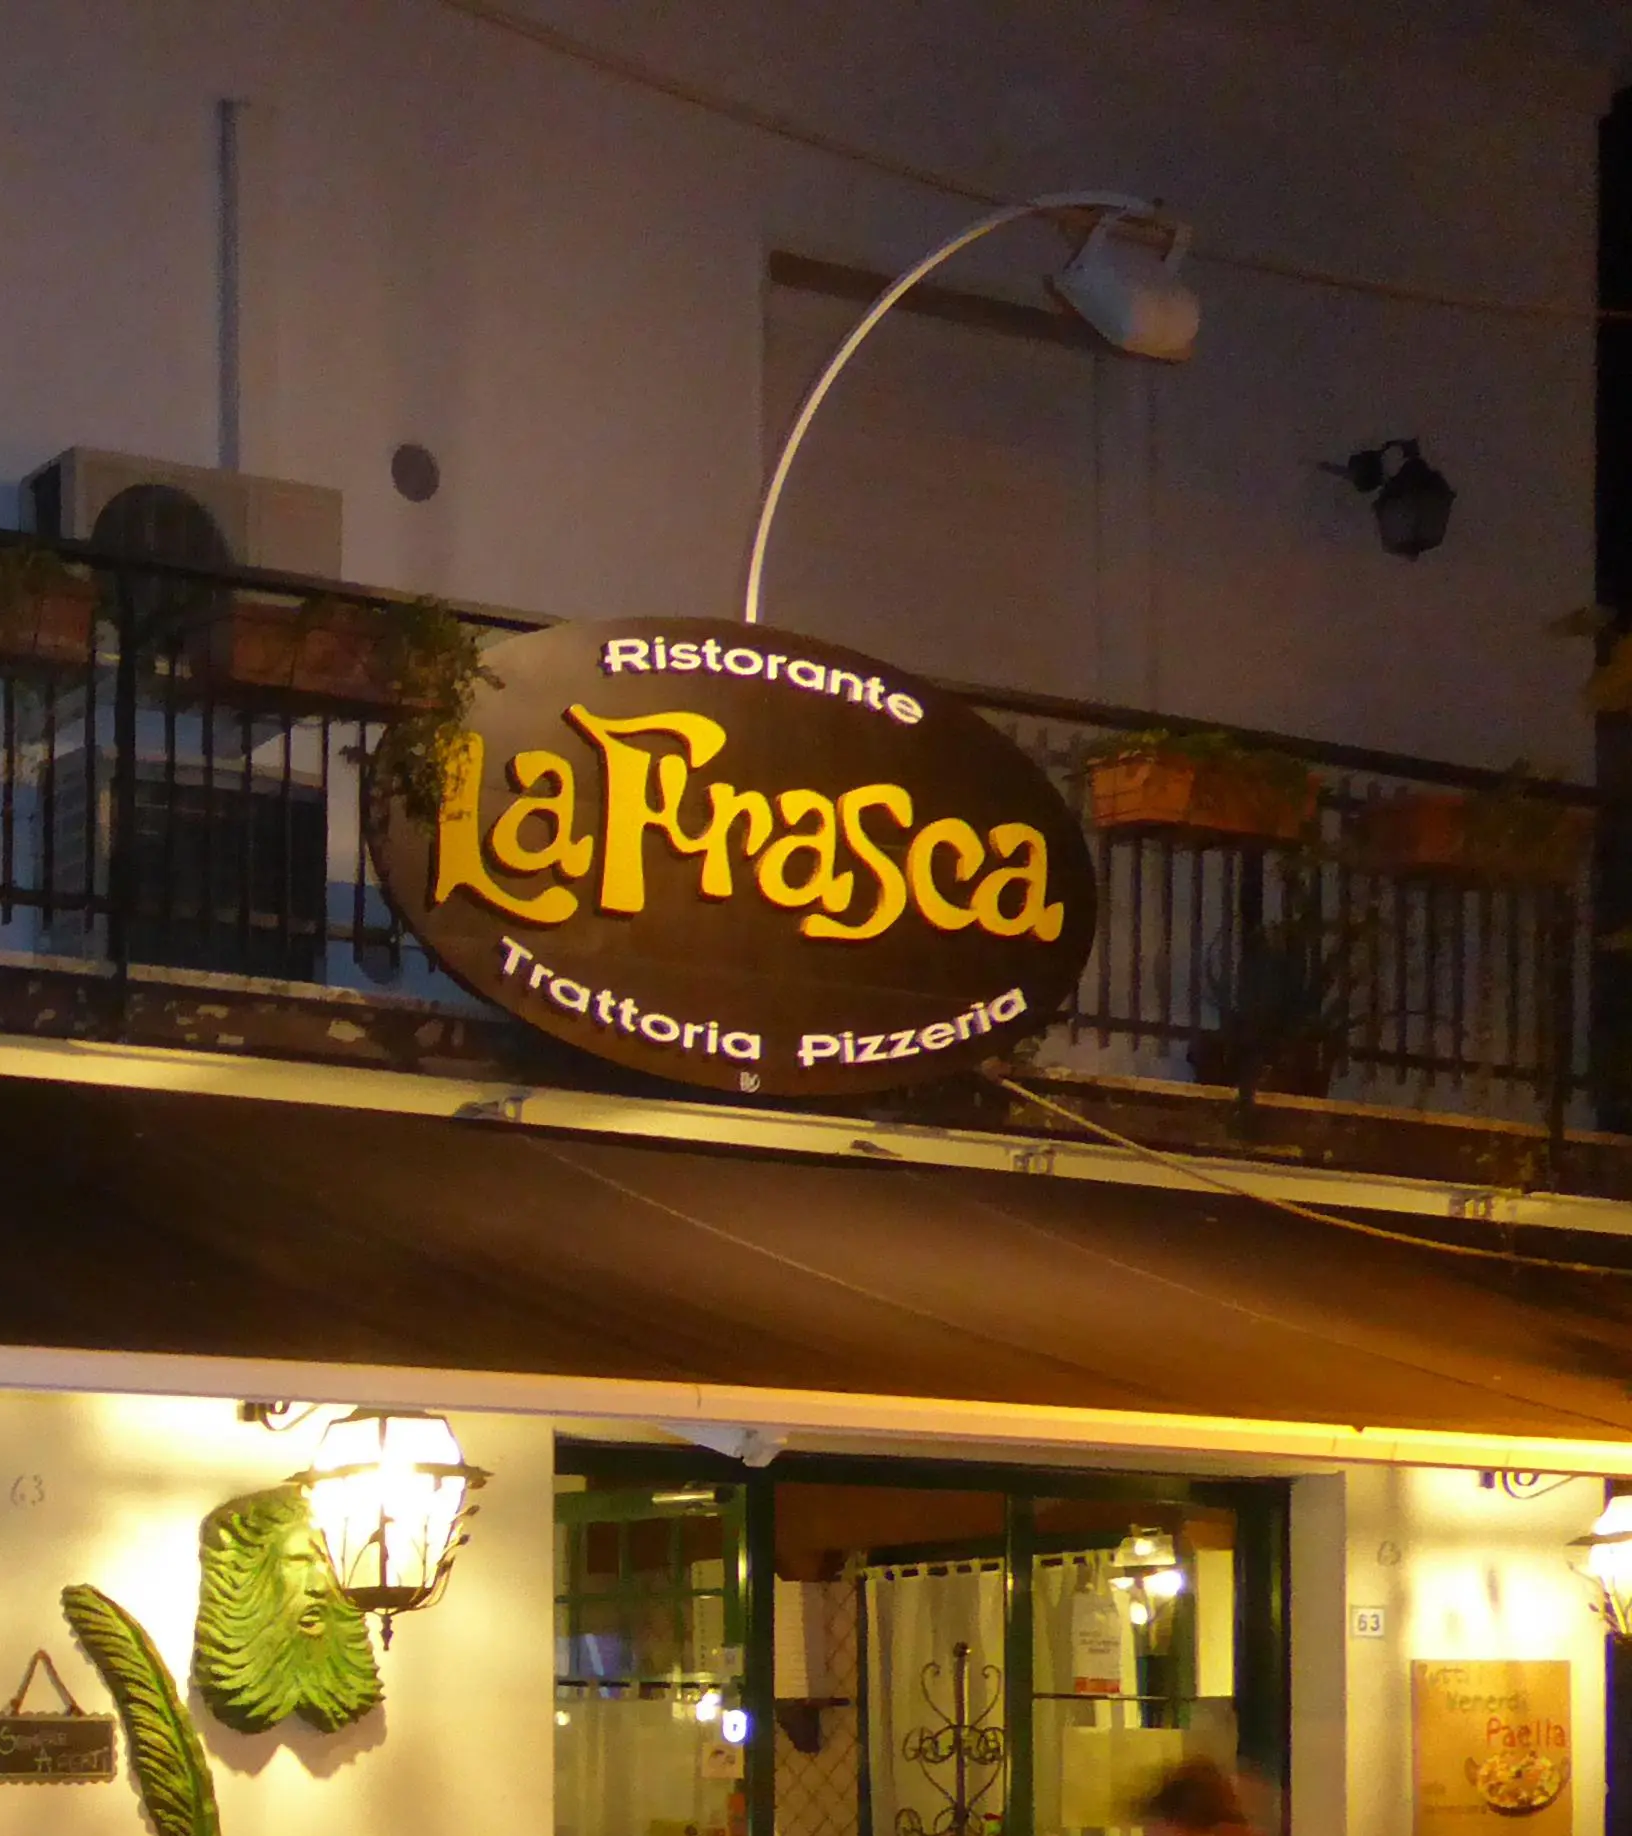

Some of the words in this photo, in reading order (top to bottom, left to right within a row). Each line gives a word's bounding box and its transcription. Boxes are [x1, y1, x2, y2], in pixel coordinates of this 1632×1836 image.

[602, 635, 924, 725] Ristorante
[433, 730, 595, 924] La
[562, 702, 1065, 943] Frasca
[499, 935, 762, 1060] Trattoria
[797, 986, 1028, 1067] Pizzeria
[1358, 1613, 1381, 1632] 63
[1486, 1717, 1566, 1747] Paella
